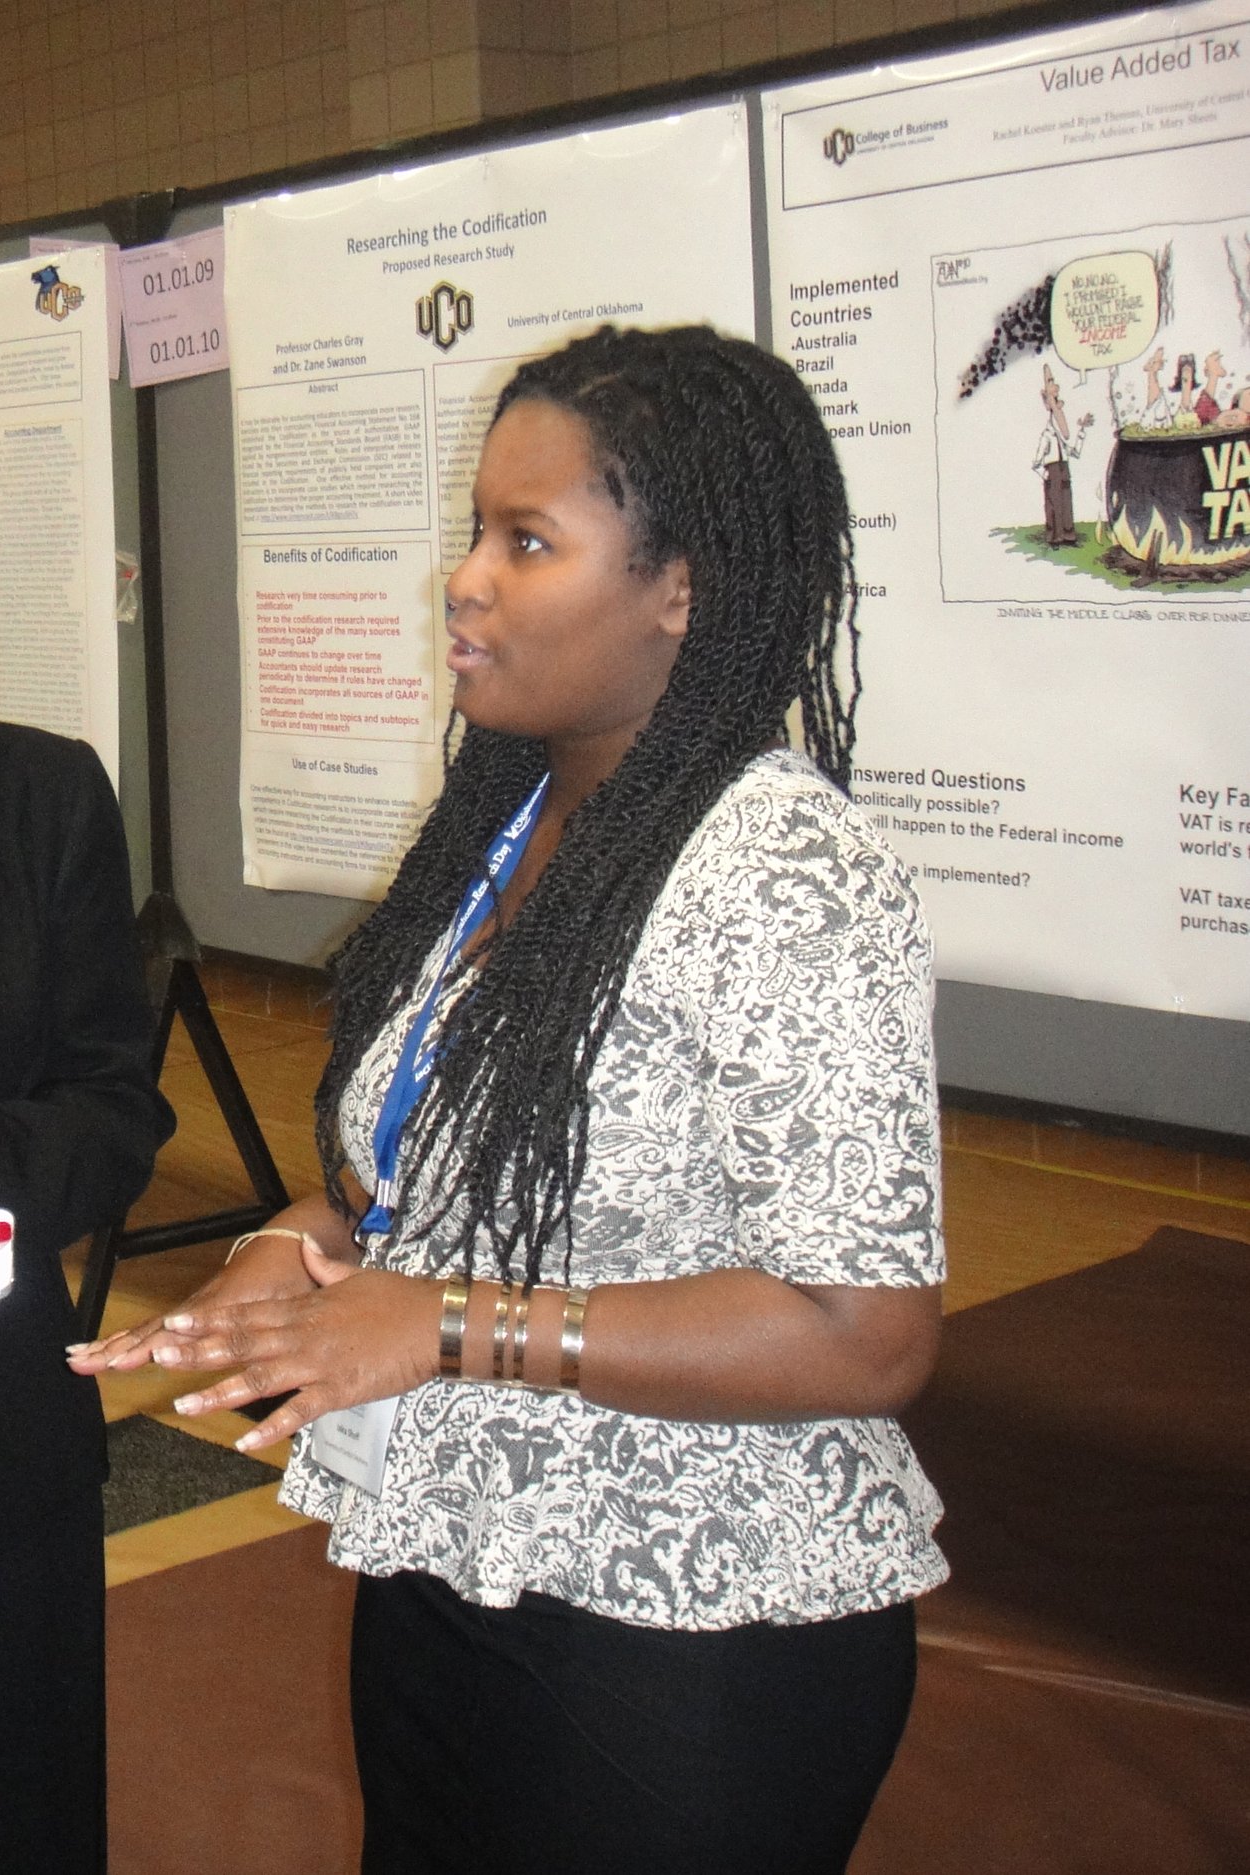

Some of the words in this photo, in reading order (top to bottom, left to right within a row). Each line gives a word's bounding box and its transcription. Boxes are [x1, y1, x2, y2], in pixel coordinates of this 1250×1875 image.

[1040, 65, 1104, 92] Value
[1111, 45, 1191, 80] Added
[1199, 38, 1240, 64] Tax
[823, 128, 855, 166] UCO
[856, 130, 890, 144] College
[893, 125, 903, 137] of
[906, 119, 948, 135] Business
[1063, 131, 1096, 145] Faculty
[347, 227, 429, 255] Researching
[433, 222, 457, 241] the
[462, 208, 547, 236] Codification
[382, 255, 430, 274] Proposed
[434, 248, 483, 267] Research
[485, 243, 515, 259] Study
[143, 259, 214, 296] 01.01.09
[790, 270, 899, 302] Implemented
[415, 280, 475, 354] UCO
[507, 314, 549, 328] University
[551, 310, 560, 322] of
[562, 306, 594, 321] Central
[596, 301, 643, 317] Oklahoma
[791, 304, 872, 328] Countries
[795, 332, 857, 350] Australia
[1079, 325, 1126, 344] INCOME
[150, 328, 220, 364] 01.01.10
[276, 342, 310, 355] Professor
[313, 337, 342, 350] Charles
[344, 335, 364, 347] Gray
[1091, 344, 1112, 356] TAX
[273, 362, 288, 374] and
[304, 359, 325, 371] Zane
[326, 355, 367, 369] Swanson
[795, 356, 834, 373] Brazil
[308, 383, 339, 394] Abstract
[820, 400, 859, 416] mark
[829, 425, 864, 439] pean
[869, 421, 911, 436] Union
[1201, 440, 1250, 491] VA
[848, 513, 897, 531] South)
[1201, 489, 1250, 540] TA
[263, 549, 307, 563] Benefits
[311, 548, 322, 562] of
[325, 547, 398, 562] Codification
[360, 592, 377, 601] prior
[379, 592, 387, 600] to
[334, 616, 365, 624] research
[368, 616, 400, 626] required
[997, 607, 1043, 618] INVITING
[1047, 609, 1065, 619] THE
[1068, 609, 1108, 619] MIDDLE
[1113, 610, 1152, 621] CLASS
[1157, 611, 1186, 622] OVER
[1189, 611, 1210, 622] FOR
[1213, 612, 1250, 623] DINNE
[369, 628, 400, 636] sources
[388, 677, 422, 688] changed
[395, 690, 419, 700] GAAP
[292, 758, 306, 770] Use
[308, 760, 318, 771] of
[319, 760, 341, 773] Case
[344, 762, 378, 776] Studies
[853, 769, 925, 786] nswered
[931, 769, 1026, 792] Questions
[854, 792, 922, 812] politically
[927, 799, 1000, 815] possible?
[1180, 784, 1219, 810] Key
[1227, 787, 1250, 808] Fa
[893, 817, 946, 836] happen
[951, 822, 965, 836] to
[970, 823, 995, 838] the
[999, 824, 1058, 843] Federal
[1063, 829, 1124, 848] income
[1179, 813, 1213, 831] VAT
[1218, 816, 1232, 832] is
[492, 843, 512, 865] Day
[1180, 840, 1242, 859] world's
[924, 864, 1031, 887] implemented?
[1179, 887, 1211, 905] VAT
[1218, 892, 1250, 910] taxe
[1180, 915, 1250, 935] purchas
